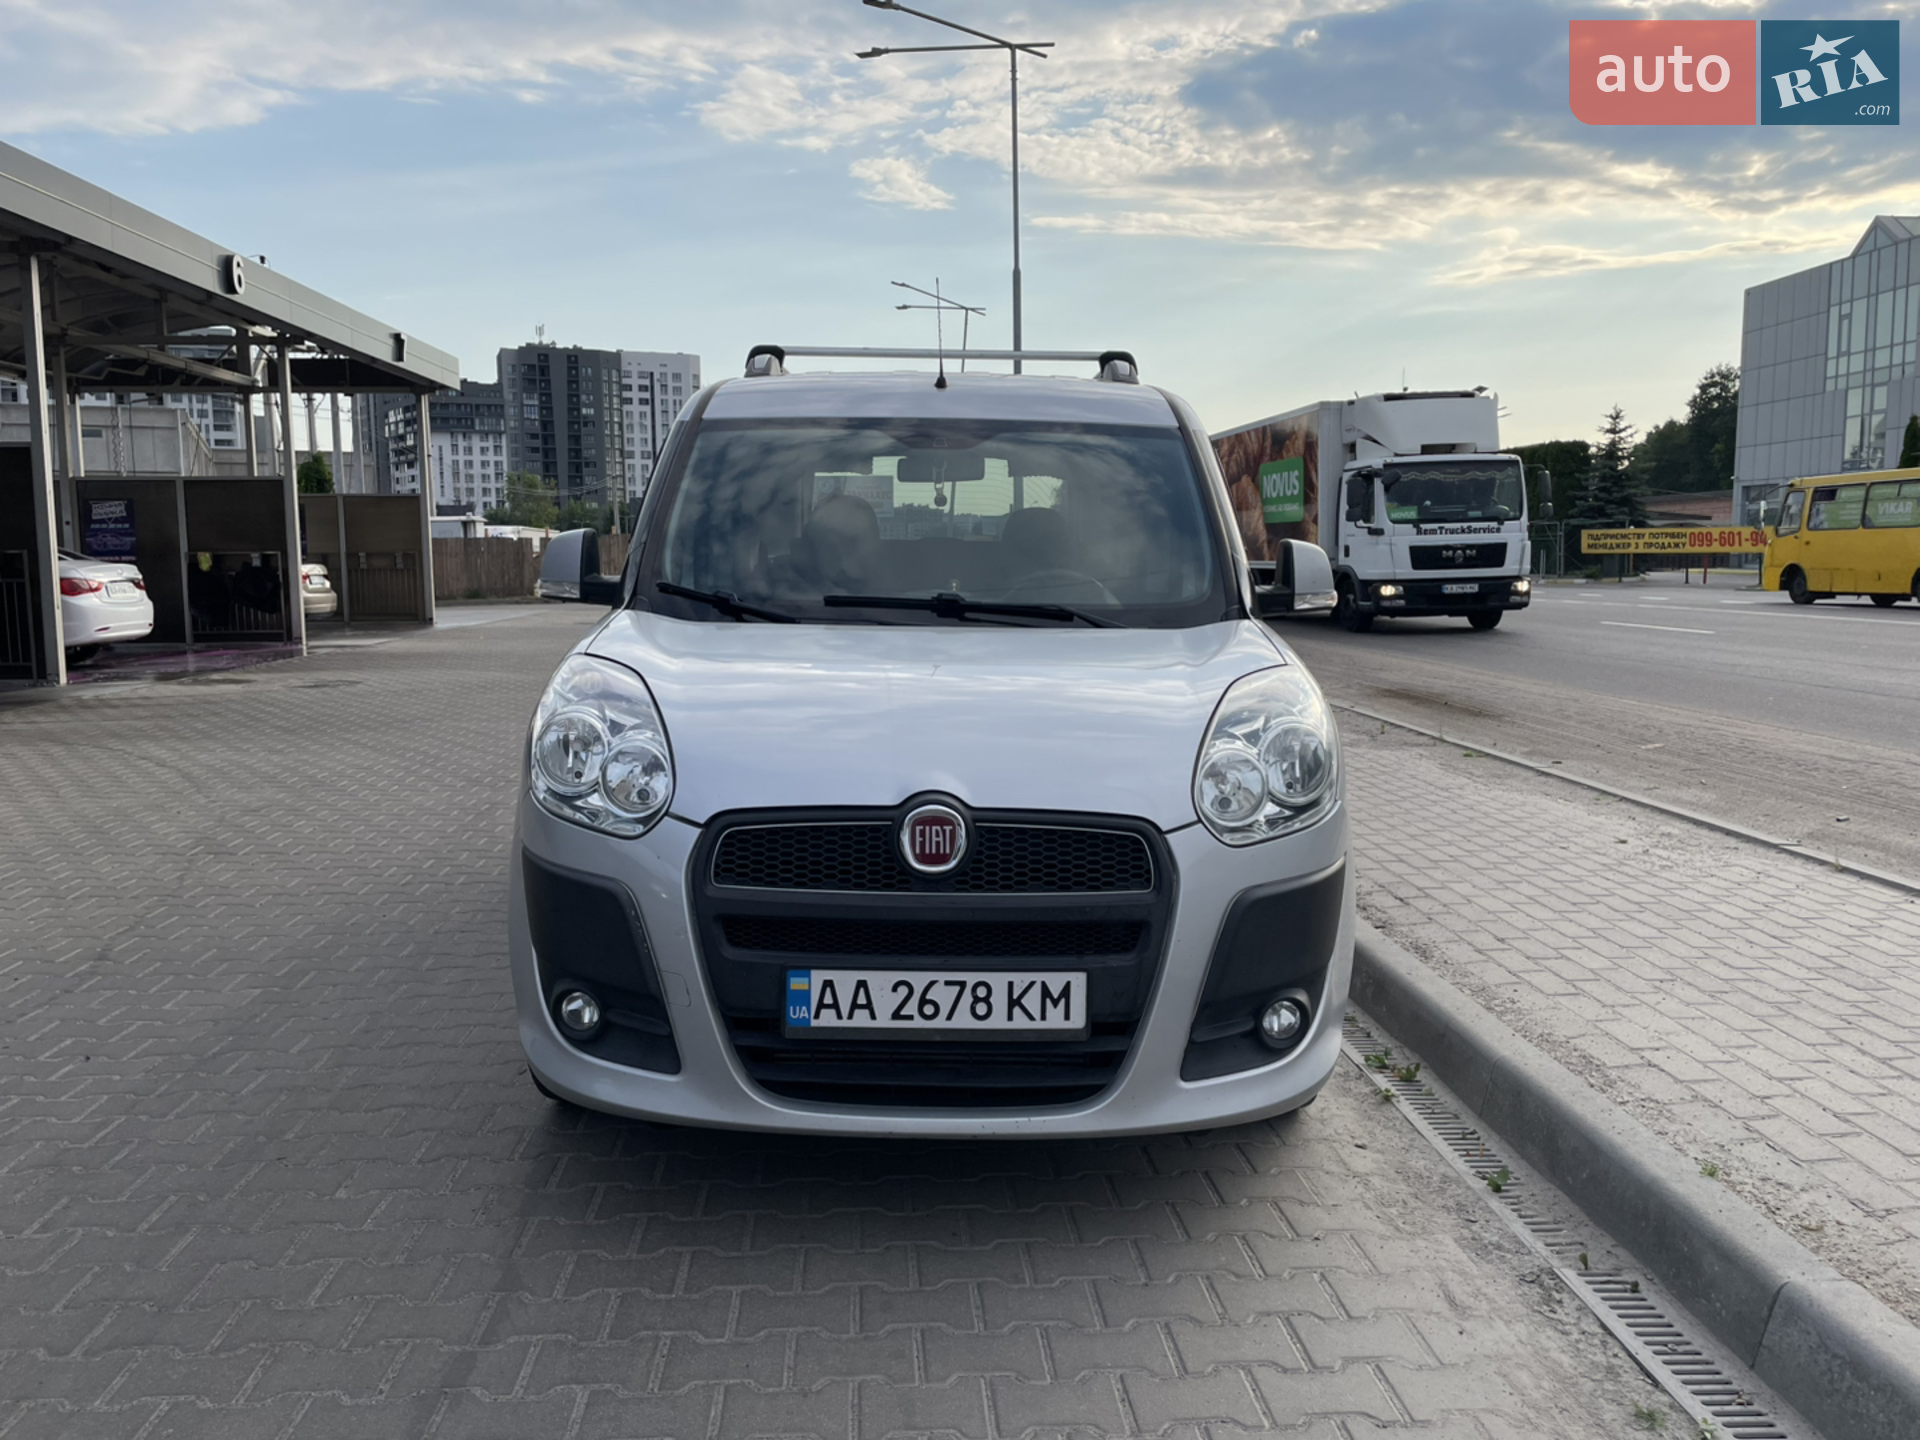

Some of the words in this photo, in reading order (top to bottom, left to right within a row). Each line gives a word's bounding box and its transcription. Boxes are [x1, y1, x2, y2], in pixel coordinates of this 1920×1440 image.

[227, 254, 245, 295] 6
[1263, 470, 1299, 499] NOVUS
[1391, 511, 1416, 519] NOVUS
[1416, 525, 1501, 535] RemTruckService
[1587, 532, 1645, 541] ПІДПРИЄМСТВУ
[1648, 532, 1687, 540] ПОТРІБЕН
[1587, 542, 1632, 550] МЕНЕДЖЕР
[1643, 541, 1687, 550] ПРОДАЖУ
[1688, 531, 1767, 547] 099-601-94
[1442, 549, 1477, 558] MAN
[915, 825, 953, 854] FIAT
[813, 979, 877, 1021] AA
[891, 980, 993, 1021] 2678
[1007, 980, 1072, 1022] KM
[790, 1006, 809, 1019] UA
